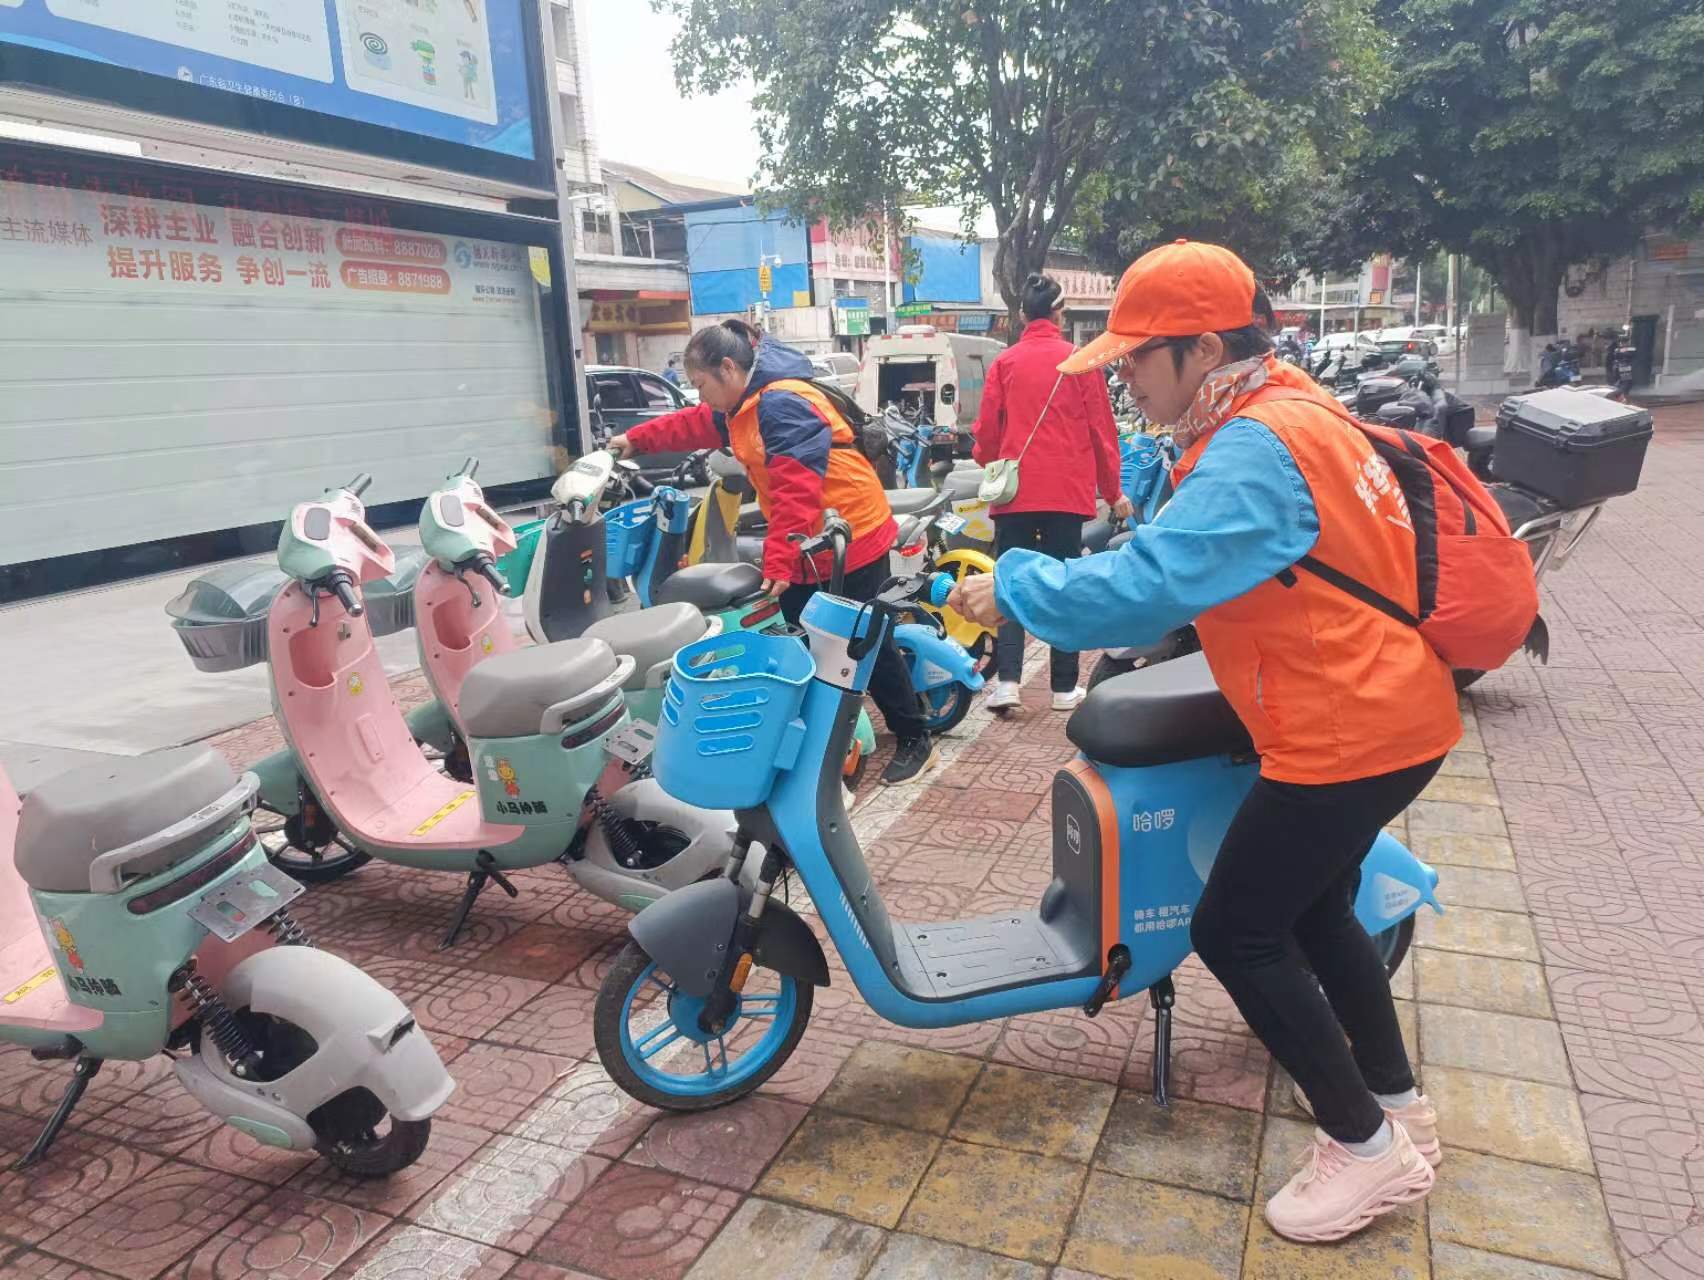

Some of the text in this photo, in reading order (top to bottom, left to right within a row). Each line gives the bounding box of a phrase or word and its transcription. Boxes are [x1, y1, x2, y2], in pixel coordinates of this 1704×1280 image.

[0, 216, 94, 247] 主流媒体
[100, 203, 219, 245] 深耕主业
[230, 217, 326, 254] 融合创新
[107, 245, 332, 289] 提升服务 争创一流
[1133, 808, 1175, 832] 哈啰
